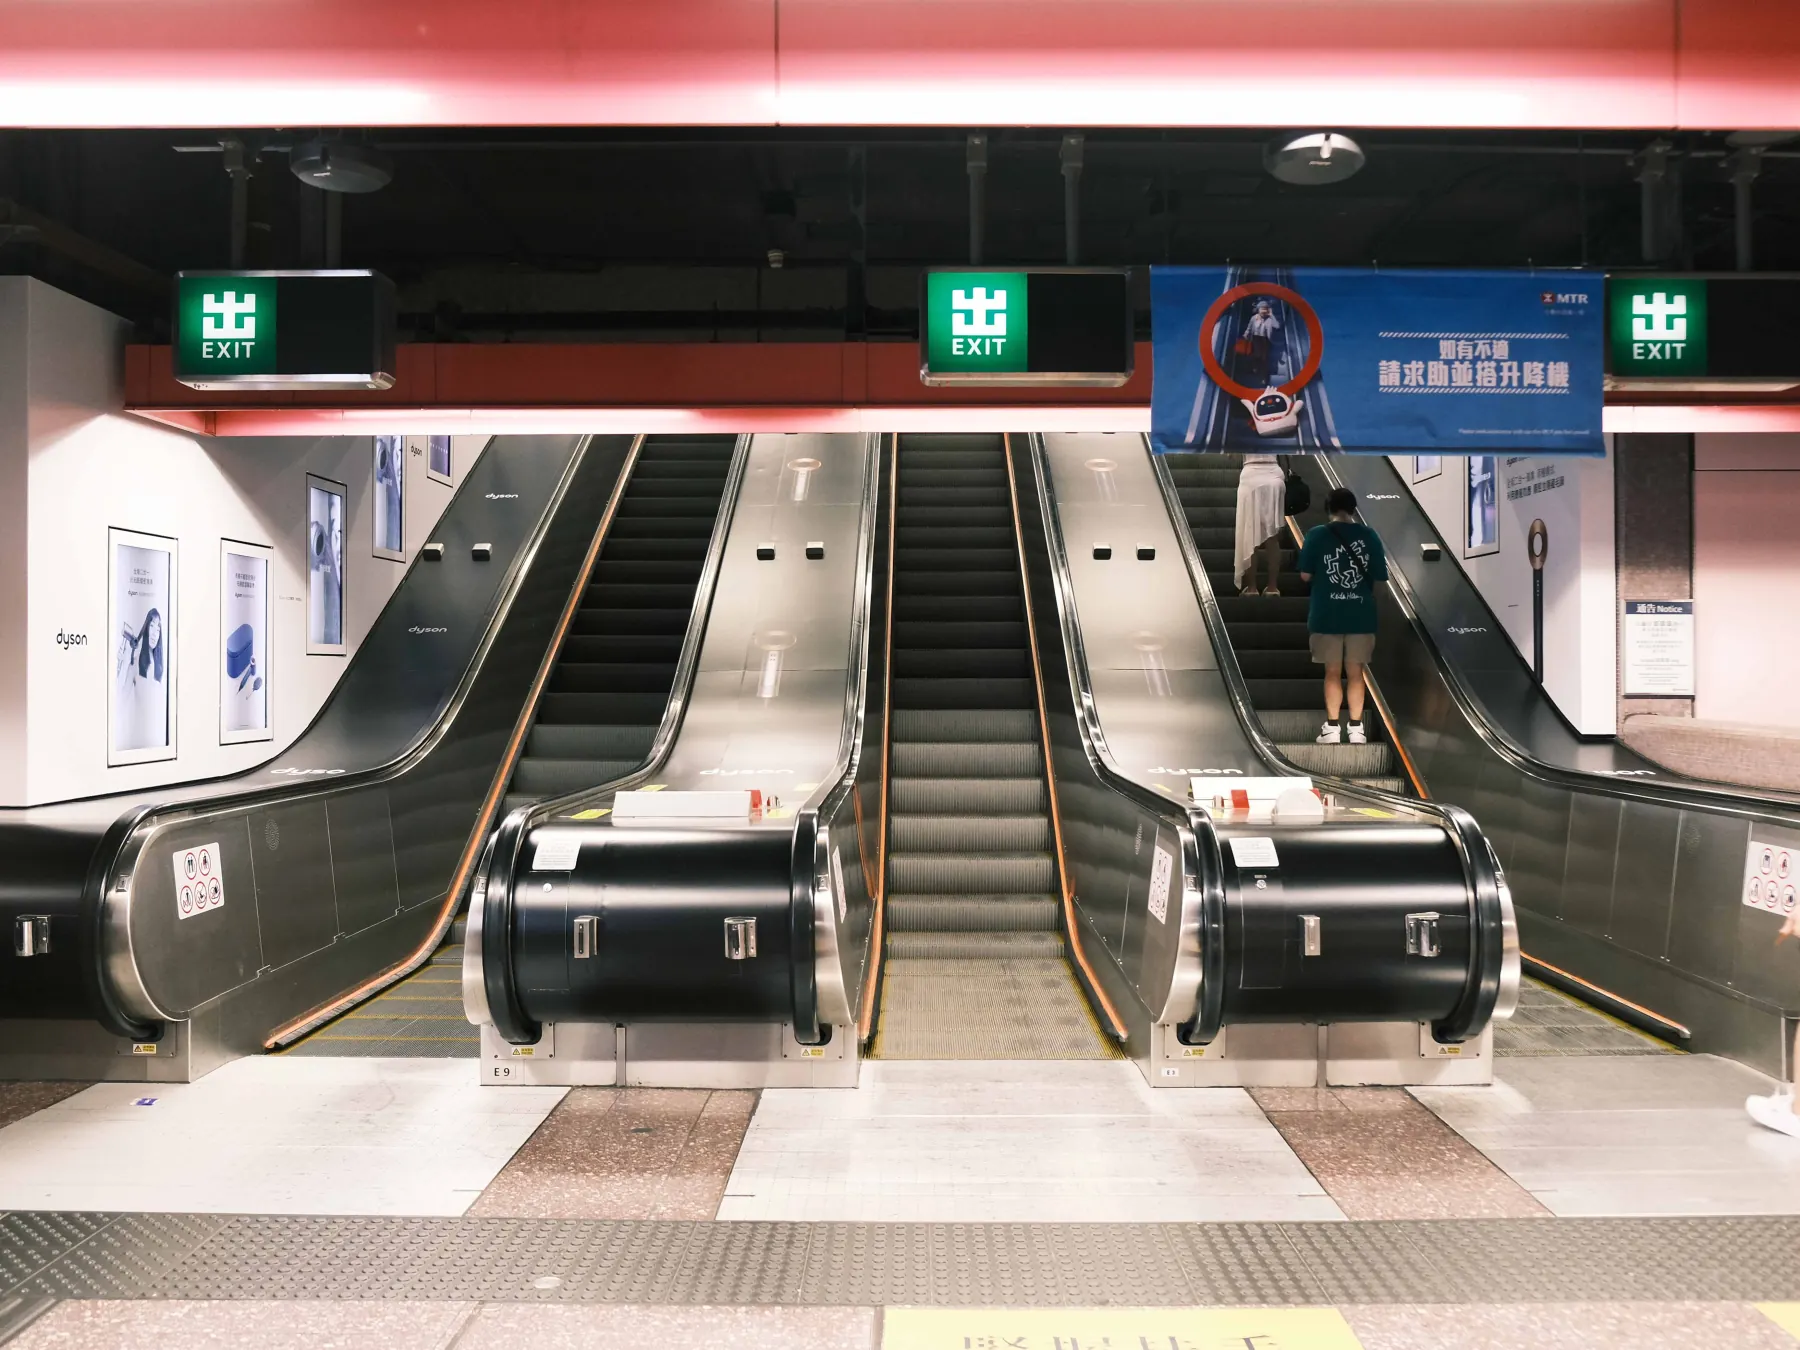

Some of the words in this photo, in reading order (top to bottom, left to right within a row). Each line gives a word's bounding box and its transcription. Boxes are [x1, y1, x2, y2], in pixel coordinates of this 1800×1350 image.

[1557, 293, 1589, 304] MTR
[202, 341, 256, 358] EXIT
[952, 338, 1007, 356] EXIT
[1439, 339, 1509, 360] 如有不適
[1632, 343, 1687, 360] EXIT
[1378, 360, 1570, 388] 請求助並搭升降機
[410, 442, 422, 456] dyson
[408, 626, 448, 634] dyson
[1447, 626, 1487, 635] dyson
[56, 628, 88, 650] dyson
[270, 767, 346, 776] dyso
[700, 768, 795, 776] dyson
[1147, 766, 1244, 776] dyson
[494, 1068, 500, 1076] E
[504, 1068, 510, 1076] 9
